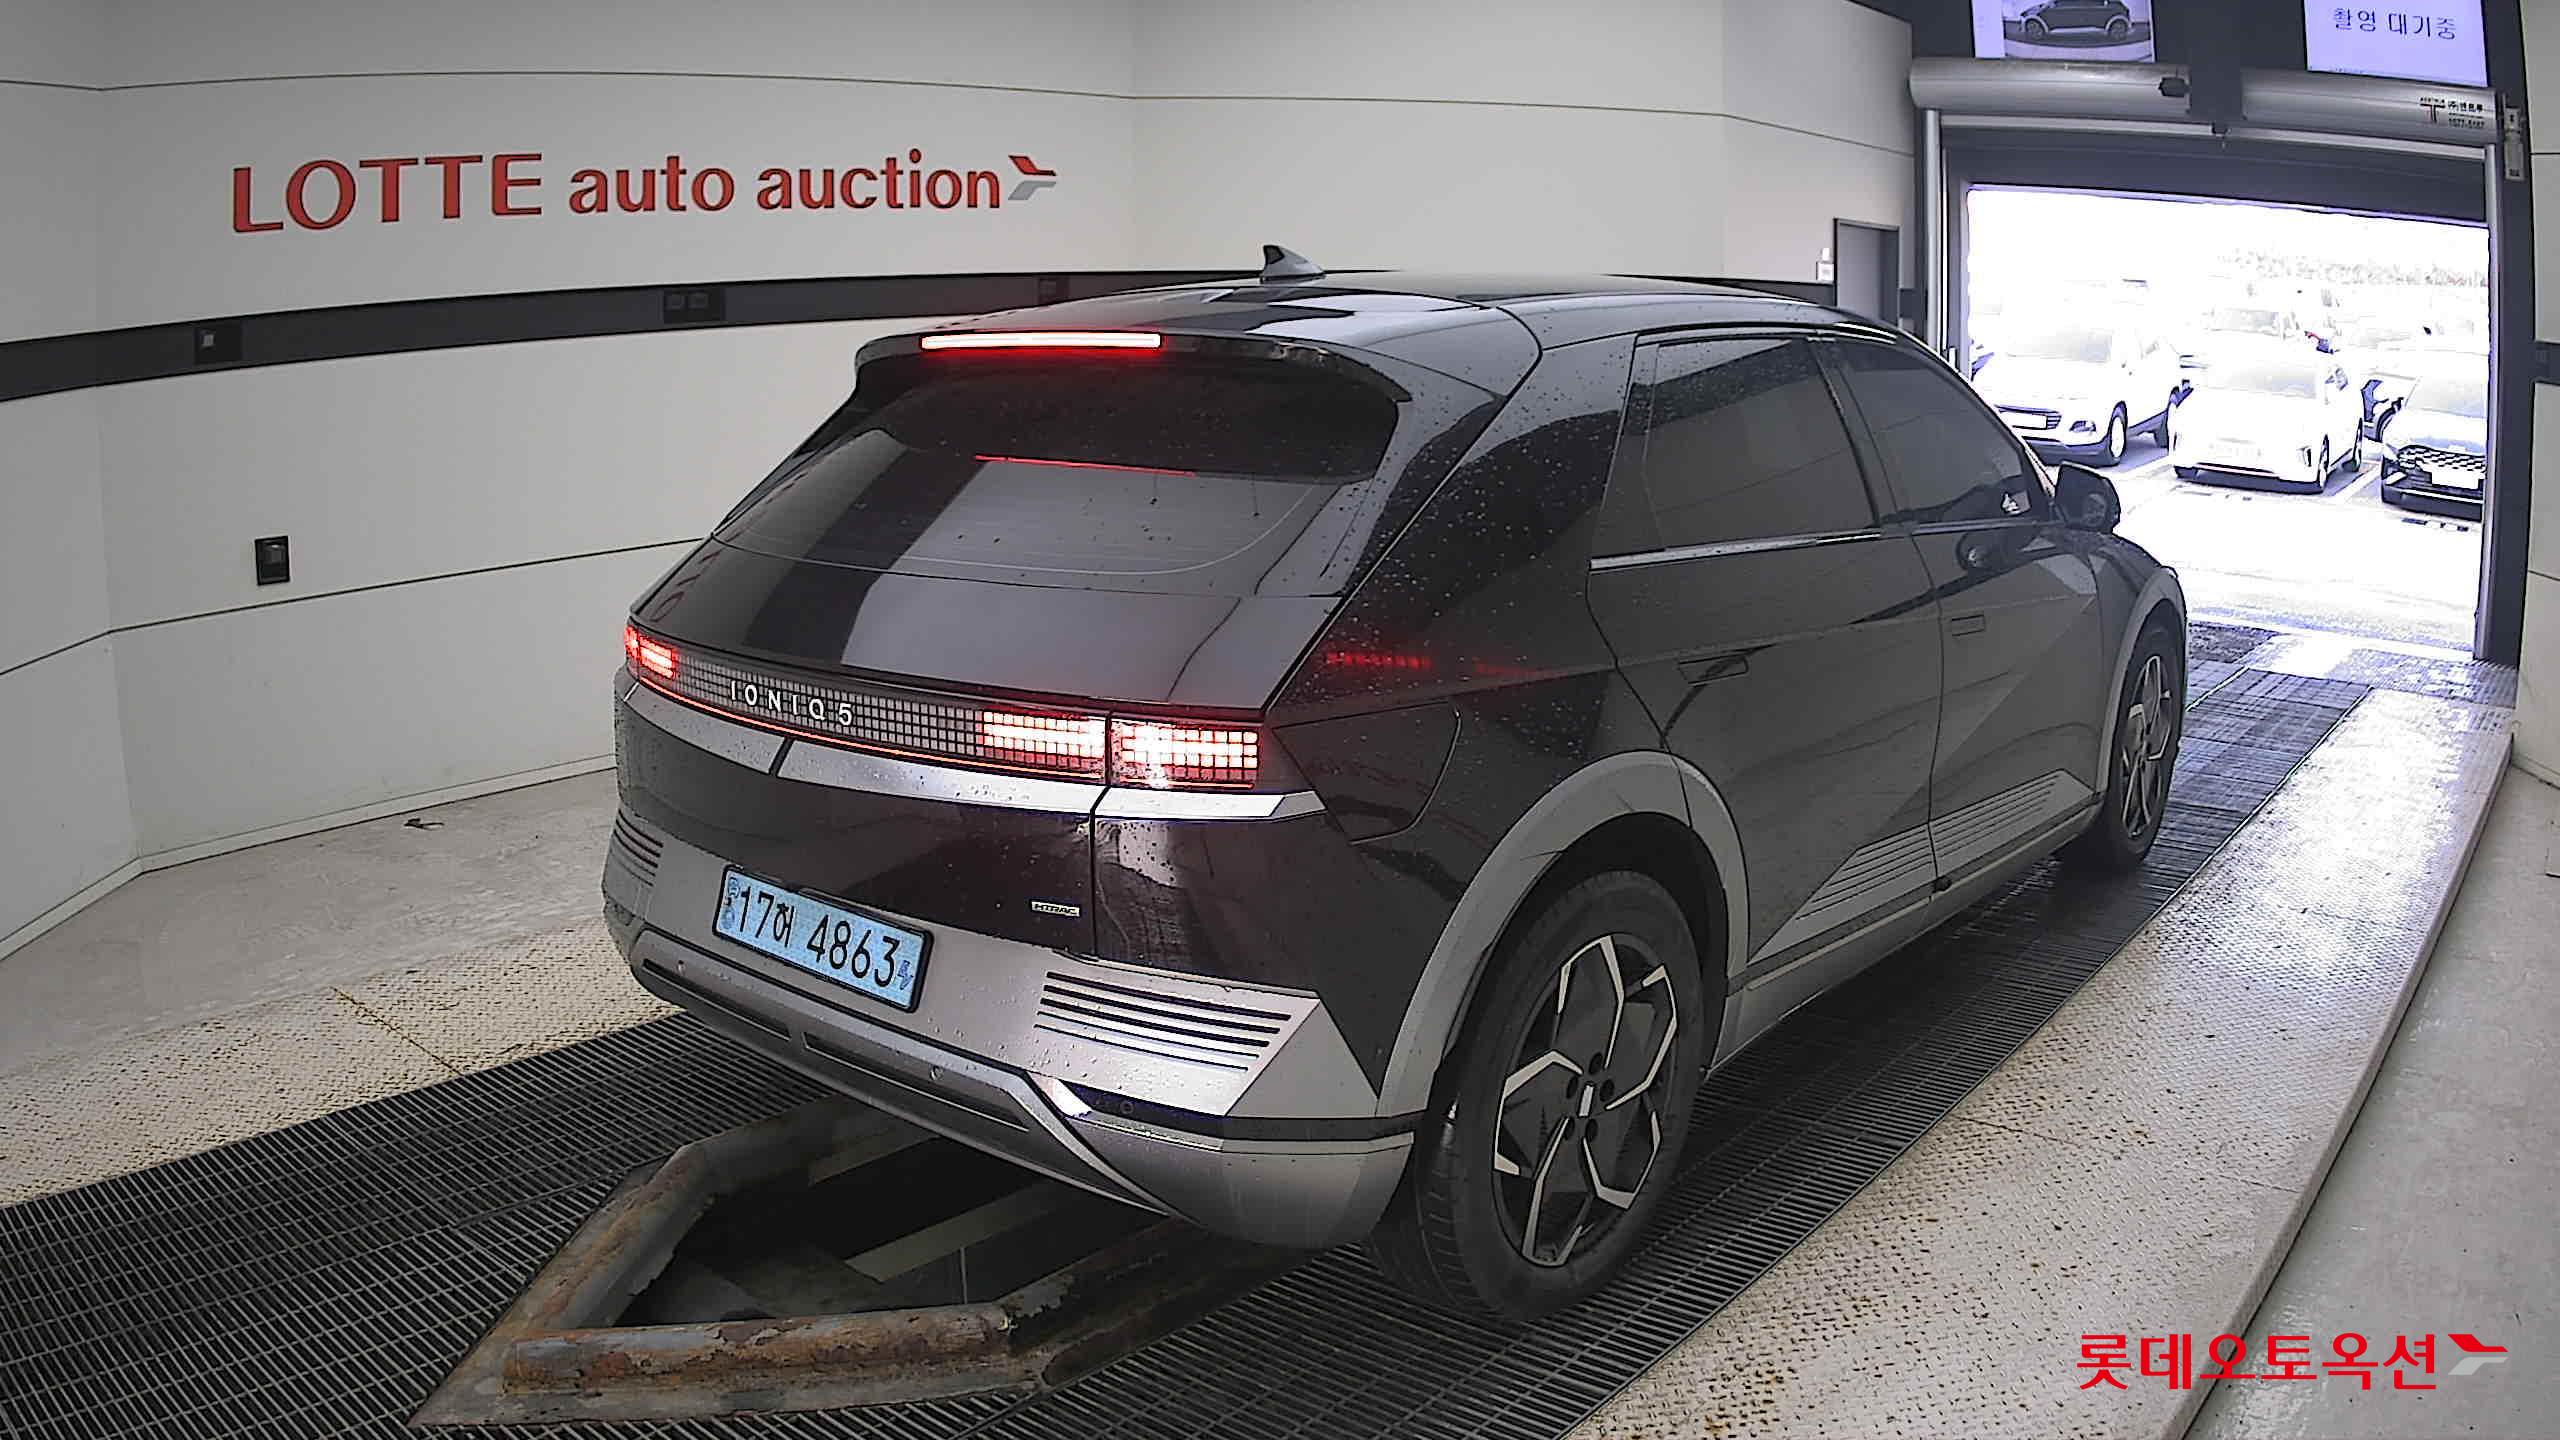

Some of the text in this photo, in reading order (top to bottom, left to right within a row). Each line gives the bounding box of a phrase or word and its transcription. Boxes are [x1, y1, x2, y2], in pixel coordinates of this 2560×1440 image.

[2333, 7, 2457, 41] 촬영 대기중
[232, 147, 1001, 233] LOTTE auto auction
[729, 680, 853, 726] IONIQ 5
[806, 913, 901, 988] 4863
